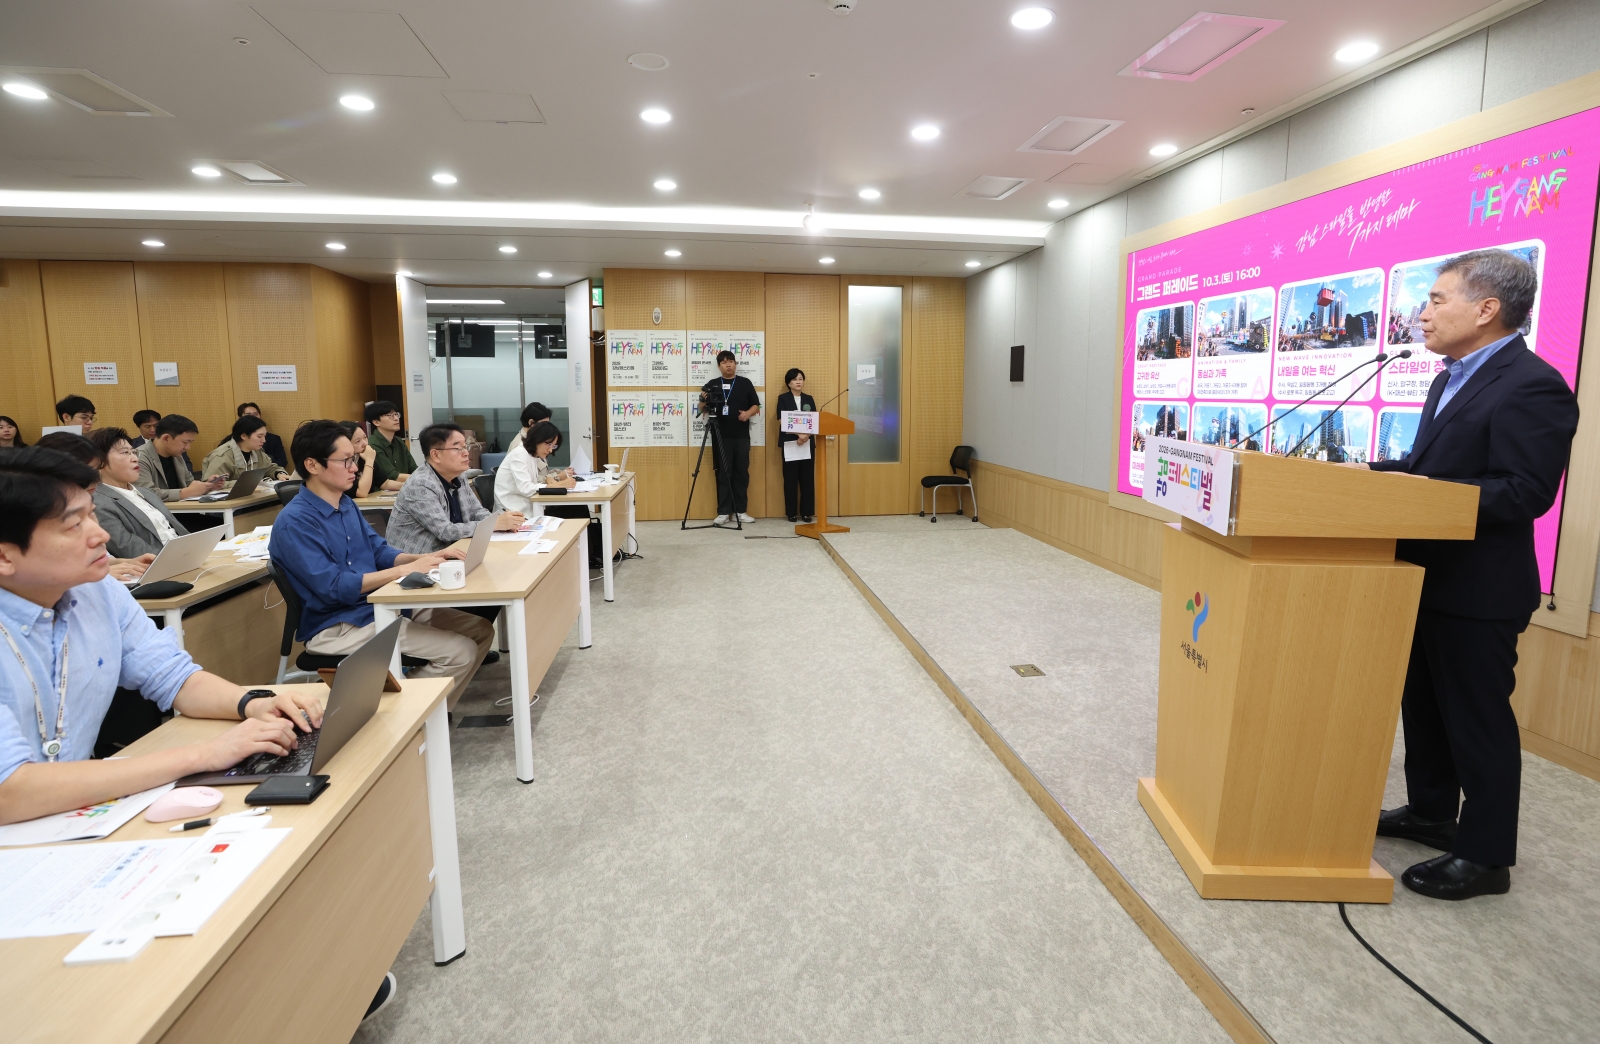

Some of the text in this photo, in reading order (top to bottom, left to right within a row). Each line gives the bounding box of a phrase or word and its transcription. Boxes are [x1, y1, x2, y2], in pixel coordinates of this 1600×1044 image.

[1521, 146, 1575, 169] FESTIVAL
[1158, 266, 1182, 278] PARADE
[1137, 283, 1161, 302] 그랜드
[1162, 274, 1199, 297] 퍼레이드
[1235, 266, 1261, 281] 16:00
[1311, 352, 1353, 360] INNOVATION
[1215, 368, 1227, 378] 가족
[1277, 364, 1336, 377] 내일을 여는 혁신
[1388, 360, 1431, 374] 스타일의
[1192, 452, 1214, 466] FESTIVAL
[1180, 640, 1208, 674] 서울특별시
